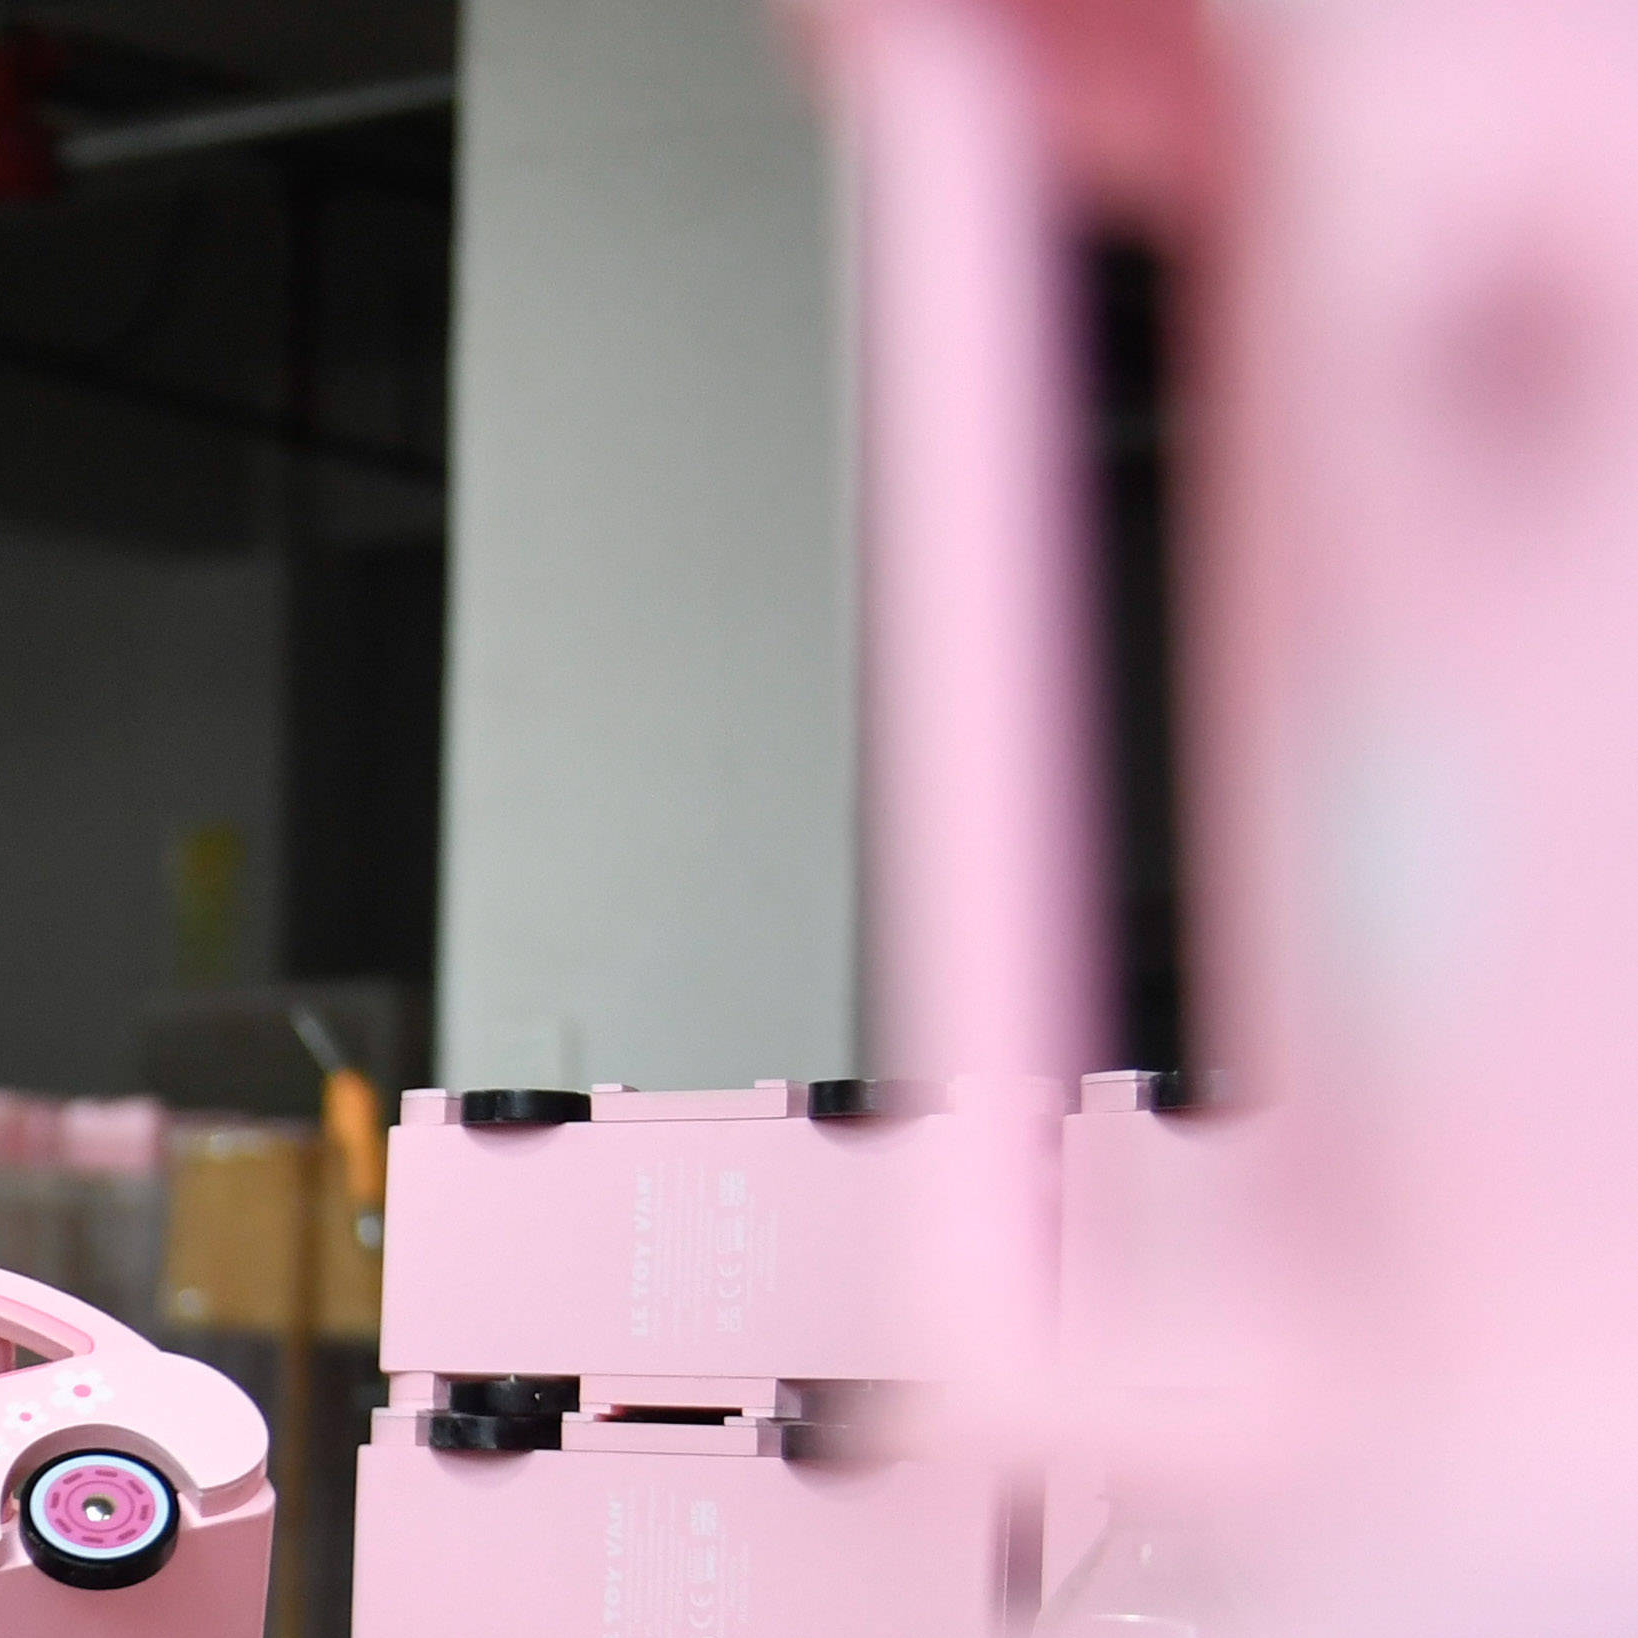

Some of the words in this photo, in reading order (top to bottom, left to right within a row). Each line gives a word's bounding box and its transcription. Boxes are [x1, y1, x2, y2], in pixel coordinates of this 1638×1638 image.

[631, 1240, 651, 1301] TOY
[630, 1305, 649, 1337] LE
[604, 1500, 624, 1559] VAN
[602, 1567, 623, 1625] TOY
